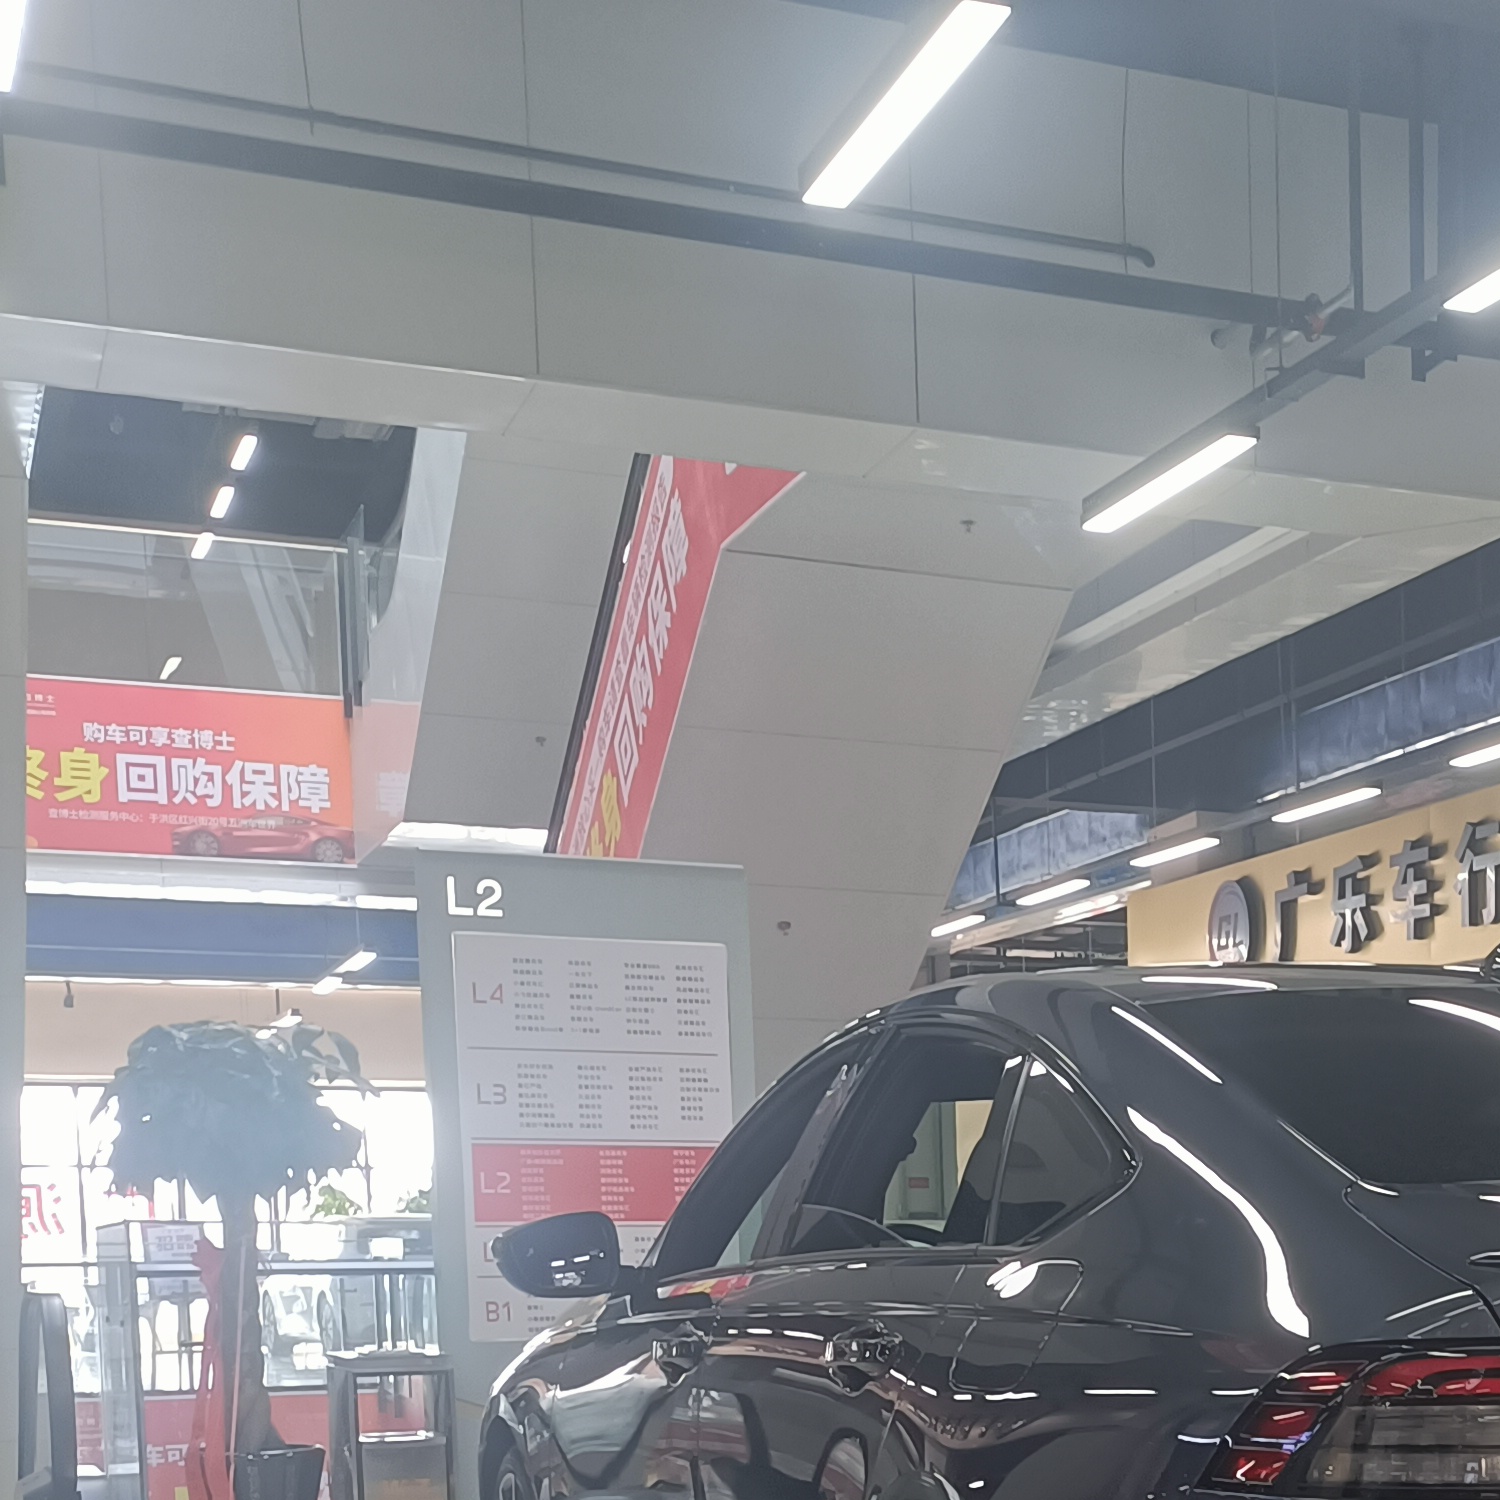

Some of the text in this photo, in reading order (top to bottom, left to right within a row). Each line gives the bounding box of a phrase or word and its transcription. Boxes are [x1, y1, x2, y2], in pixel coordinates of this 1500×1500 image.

[82, 722, 236, 752] 购车可享查博士
[446, 875, 505, 918] L2
[471, 981, 504, 1005] L4
[476, 1082, 508, 1106] L3
[480, 1171, 511, 1194] L2
[486, 1301, 512, 1323] B1
